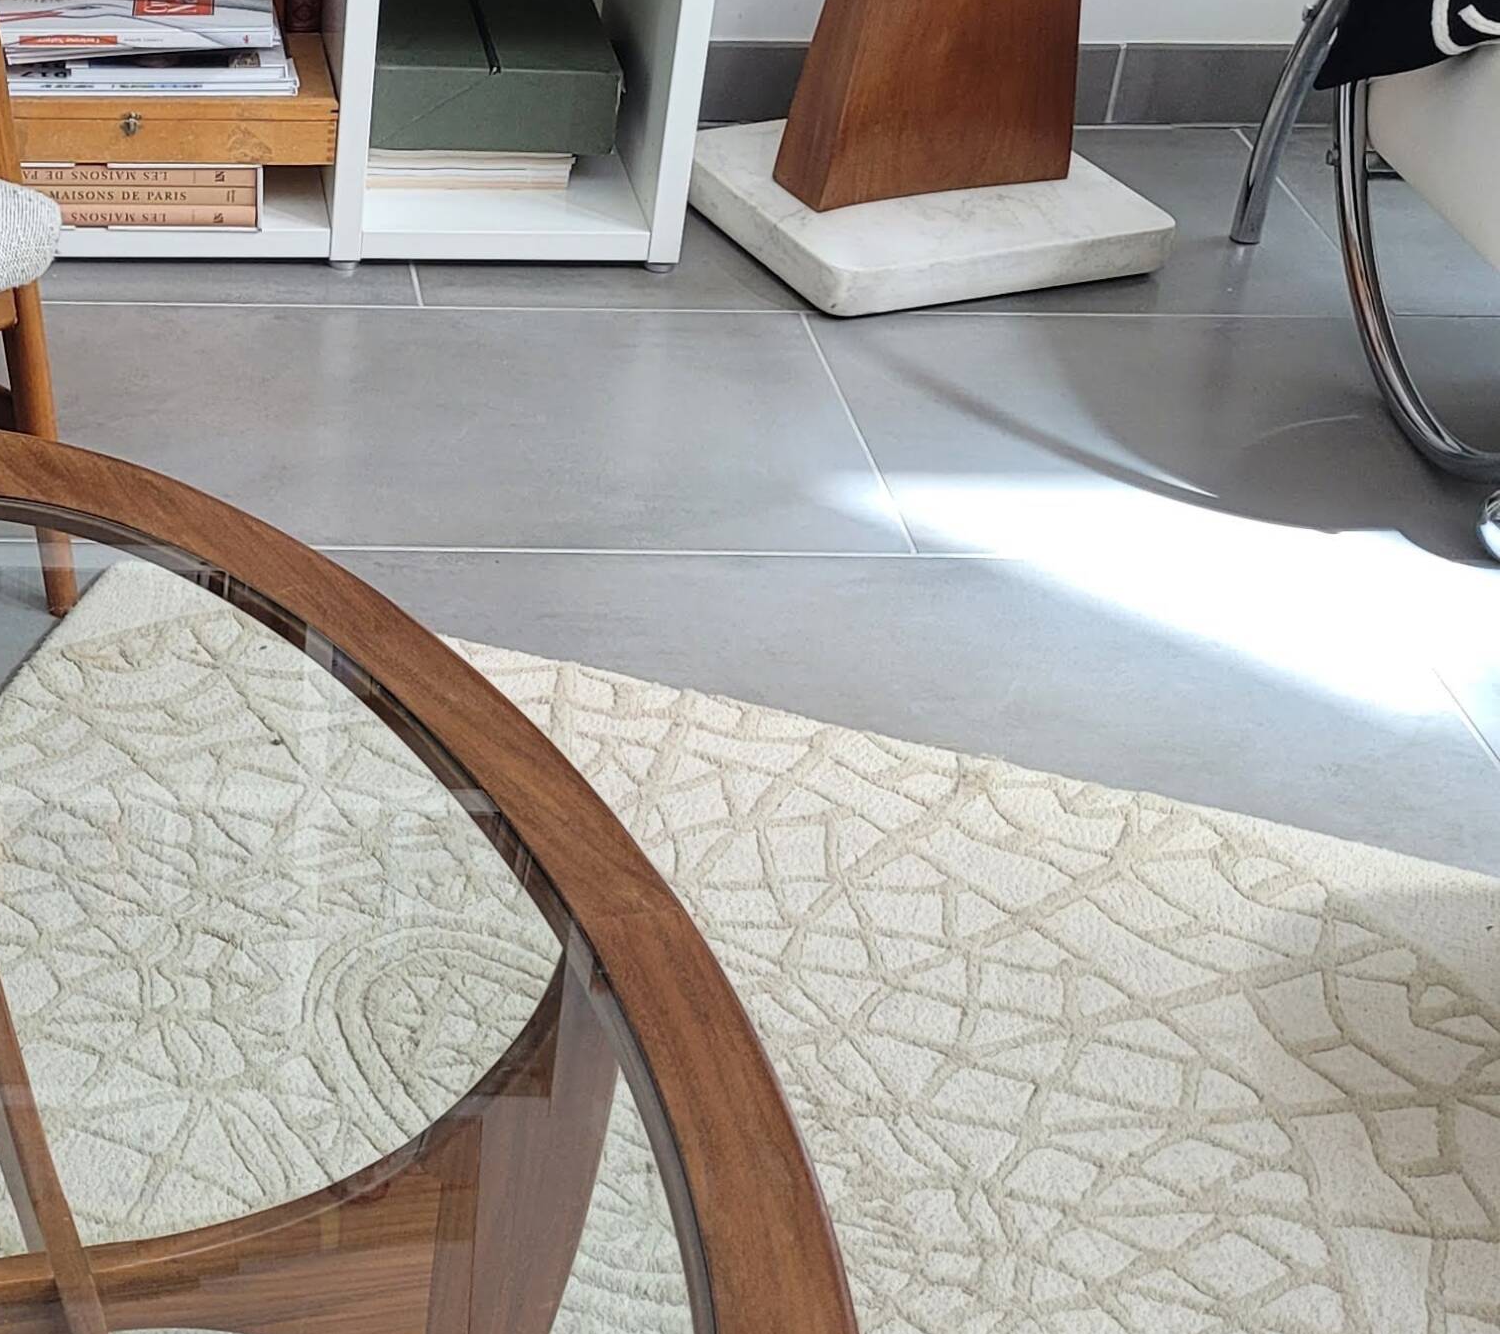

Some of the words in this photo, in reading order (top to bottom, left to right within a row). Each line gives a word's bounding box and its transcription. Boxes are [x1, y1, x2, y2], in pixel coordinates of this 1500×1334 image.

[45, 171, 63, 180] DE
[71, 171, 136, 180] MAISONS
[143, 171, 167, 180] LES
[49, 191, 114, 201] MAISONS
[122, 191, 139, 201] DE
[147, 191, 186, 201] PARIS
[71, 213, 135, 222] MAISONS
[143, 213, 166, 222] LES
